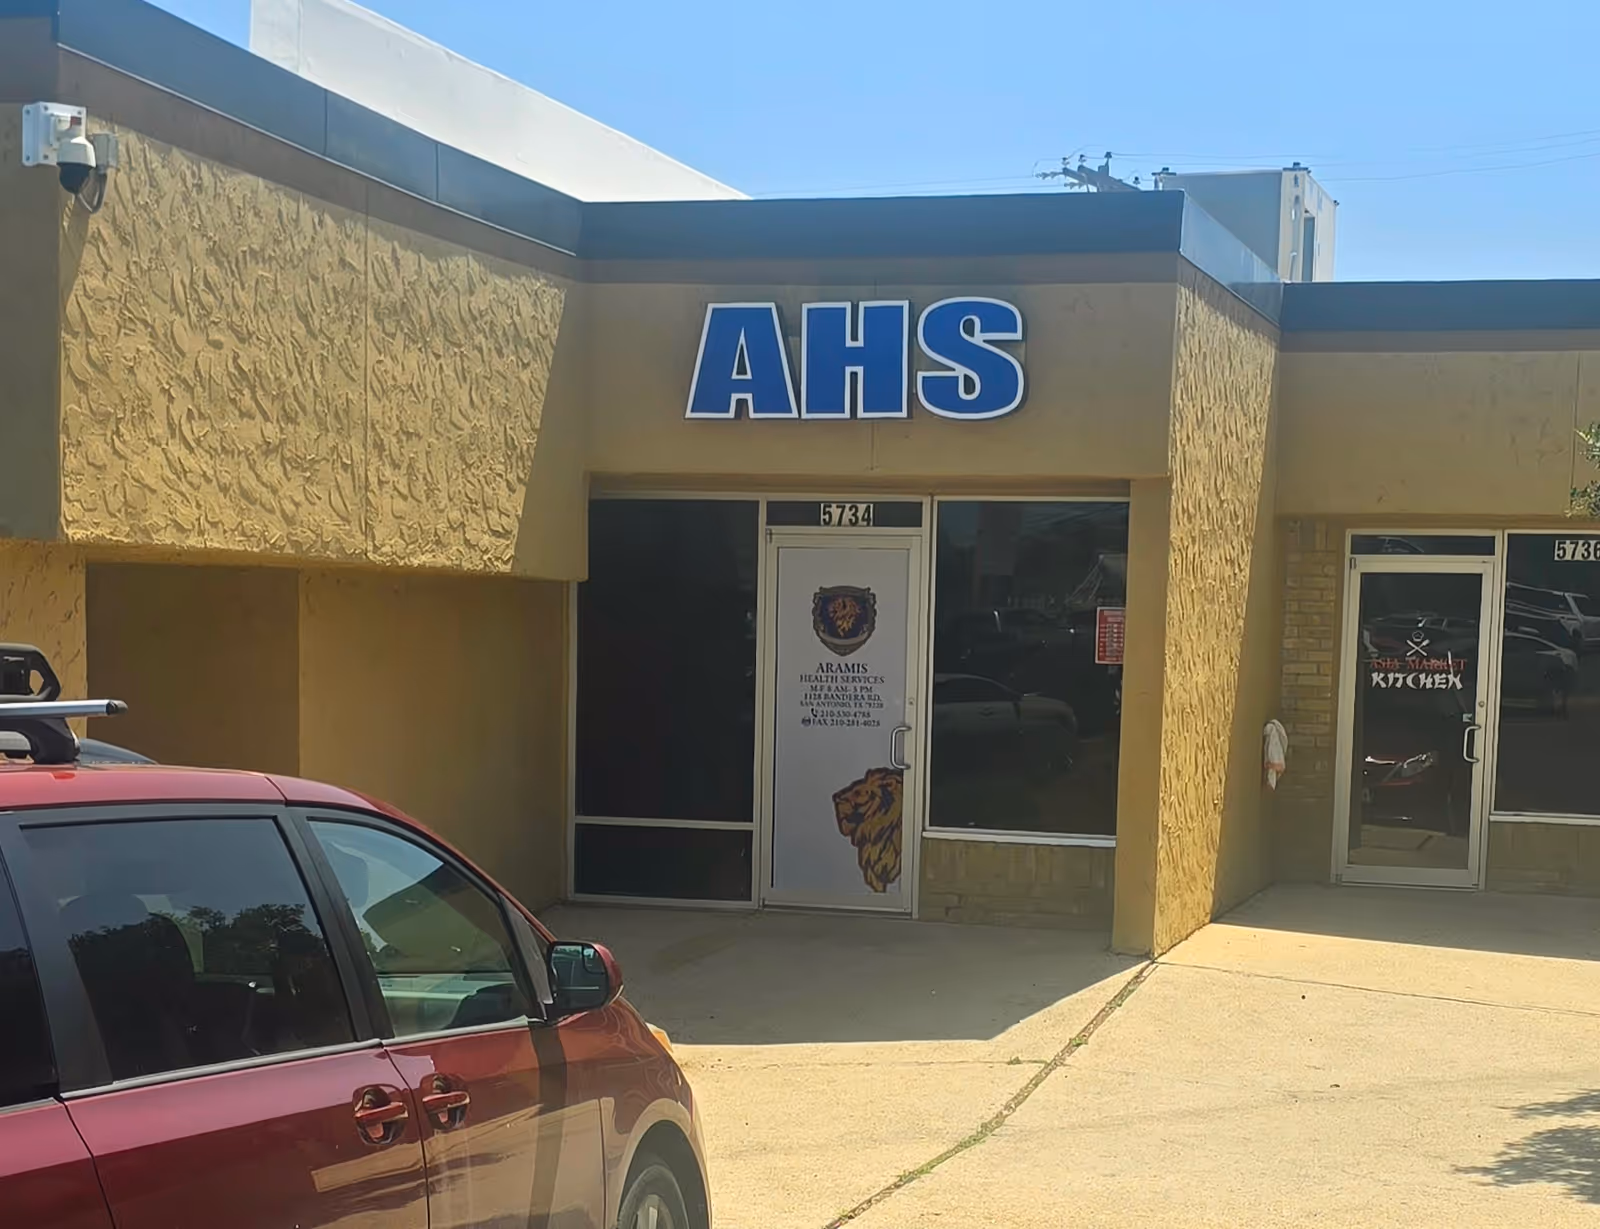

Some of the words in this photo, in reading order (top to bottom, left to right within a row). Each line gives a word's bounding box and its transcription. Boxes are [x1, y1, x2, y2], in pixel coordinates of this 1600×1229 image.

[685, 296, 1024, 420] AHS
[822, 503, 872, 527] 5734
[1556, 540, 1600, 560] 5736
[816, 662, 868, 674] ARAMIS
[1371, 651, 1463, 690] KITCHEN
[800, 674, 838, 683] HEALTH
[840, 675, 885, 684] SERVICES
[823, 693, 865, 701] BANDERA
[812, 718, 828, 726] FAX
